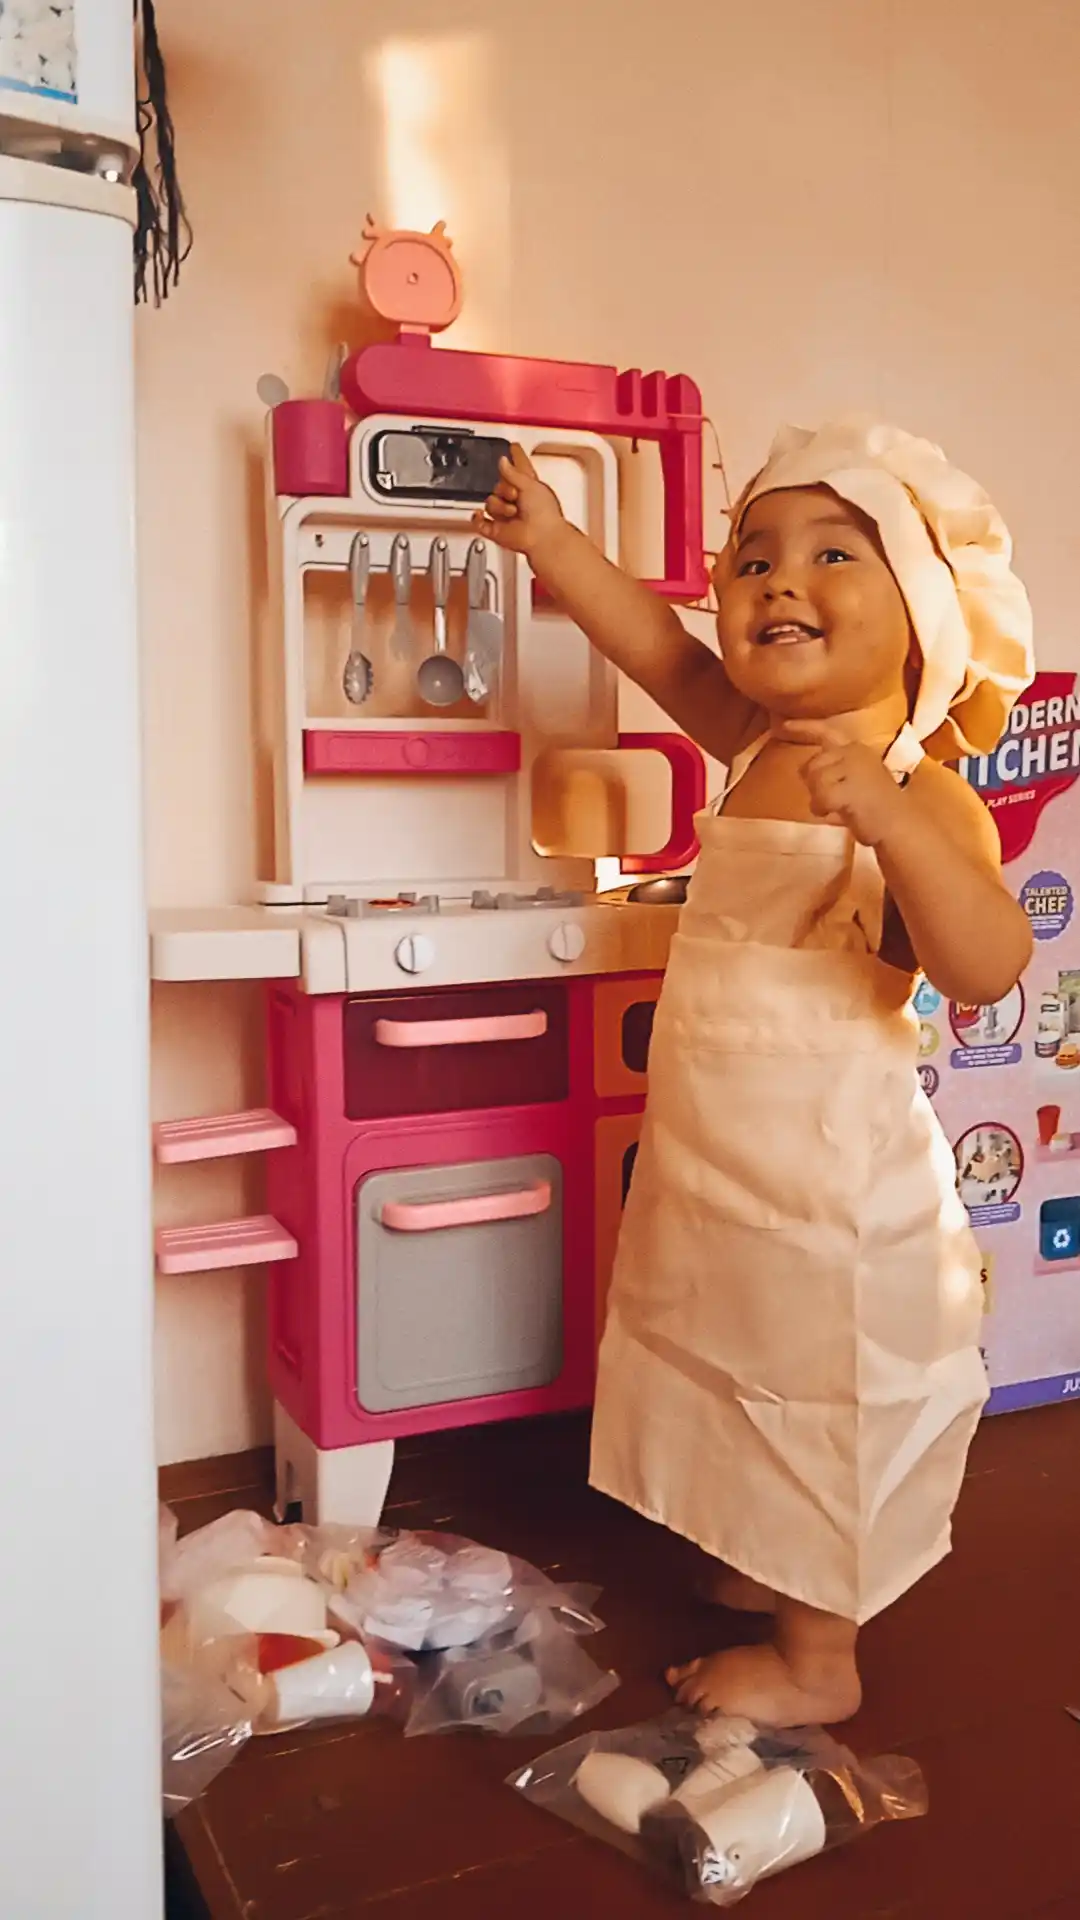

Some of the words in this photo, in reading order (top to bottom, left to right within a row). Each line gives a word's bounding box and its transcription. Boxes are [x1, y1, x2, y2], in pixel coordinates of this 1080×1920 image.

[1010, 693, 1080, 735] DERN
[959, 728, 1080, 786] ITCHE
[1024, 896, 1068, 915] CHEF
[1062, 1377, 1080, 1394] JU
